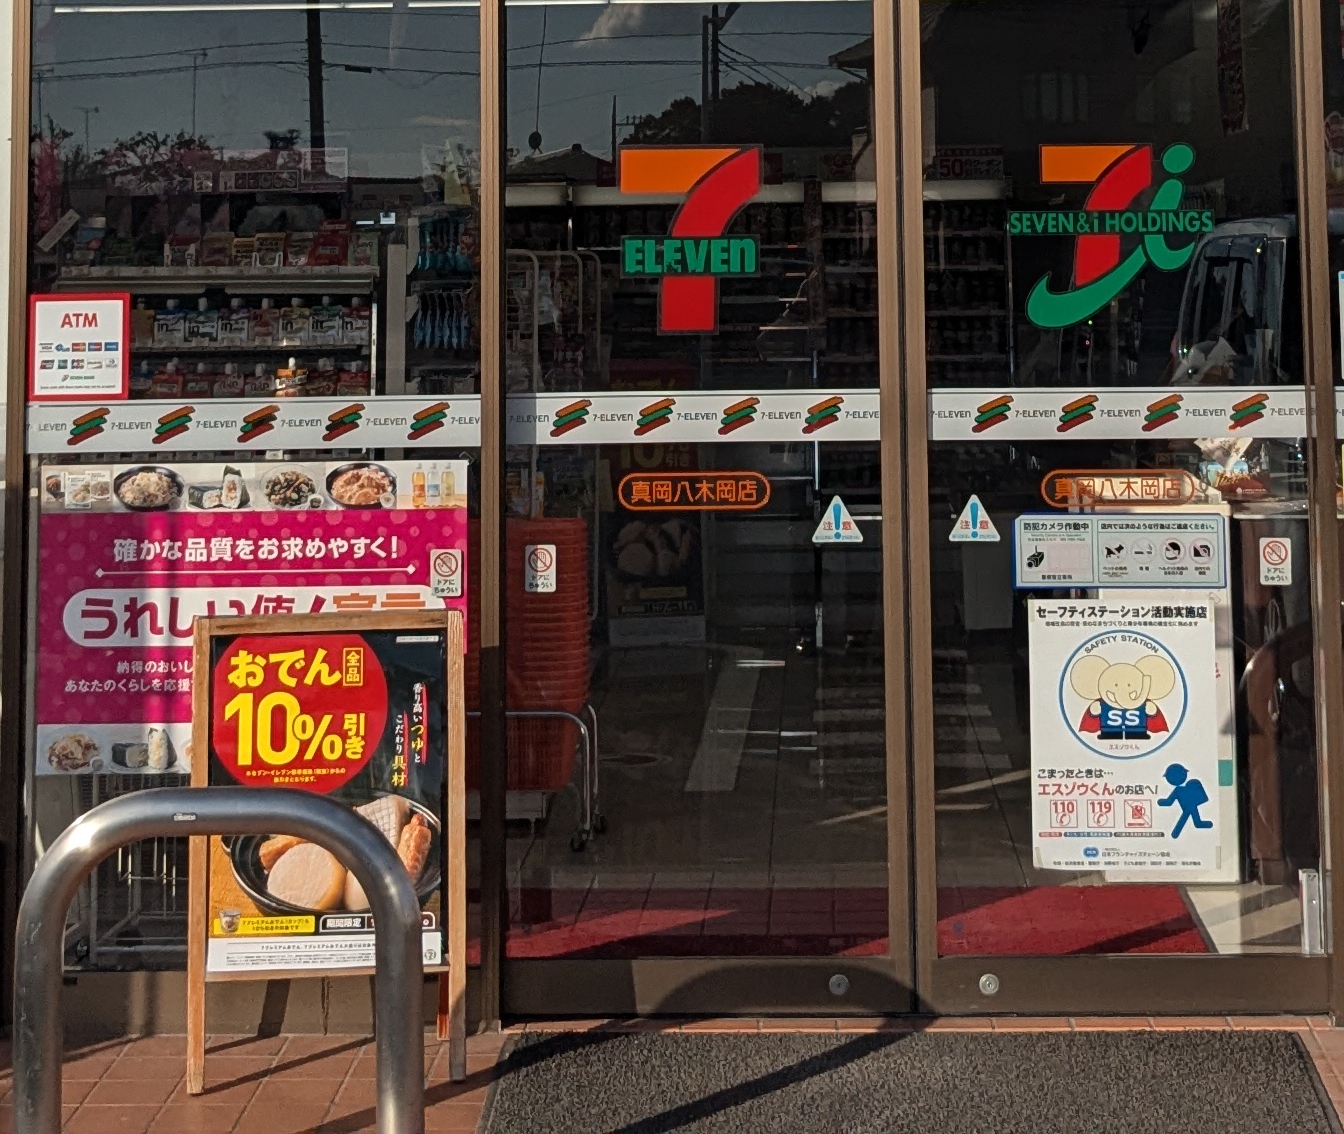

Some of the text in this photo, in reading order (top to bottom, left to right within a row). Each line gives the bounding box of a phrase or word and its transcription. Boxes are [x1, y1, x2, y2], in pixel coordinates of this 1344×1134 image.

[1104, 209, 1214, 234] HOLDINGS
[619, 146, 761, 332] 7
[60, 313, 98, 328] ATM
[630, 480, 757, 504] 真岡八木岡店
[1053, 476, 1183, 501] 真岡八木岡店
[1023, 522, 1090, 531] 防犯カメラ作動中
[113, 536, 400, 564] 確かな品質をお求めやすく!
[1036, 605, 1208, 619] セーフティステーション活動実施店
[1084, 635, 1160, 654] SAFETY STATION
[227, 648, 342, 689] おでん
[345, 650, 361, 684] 全品
[64, 677, 194, 693] あなたのくらしを応援
[225, 691, 343, 766] 10%
[410, 682, 425, 764] 香り高いつゆと
[1107, 711, 1141, 727] SS
[343, 712, 365, 759] 引き
[391, 714, 407, 787] こだわり具材
[1052, 801, 1112, 814] 110 119
